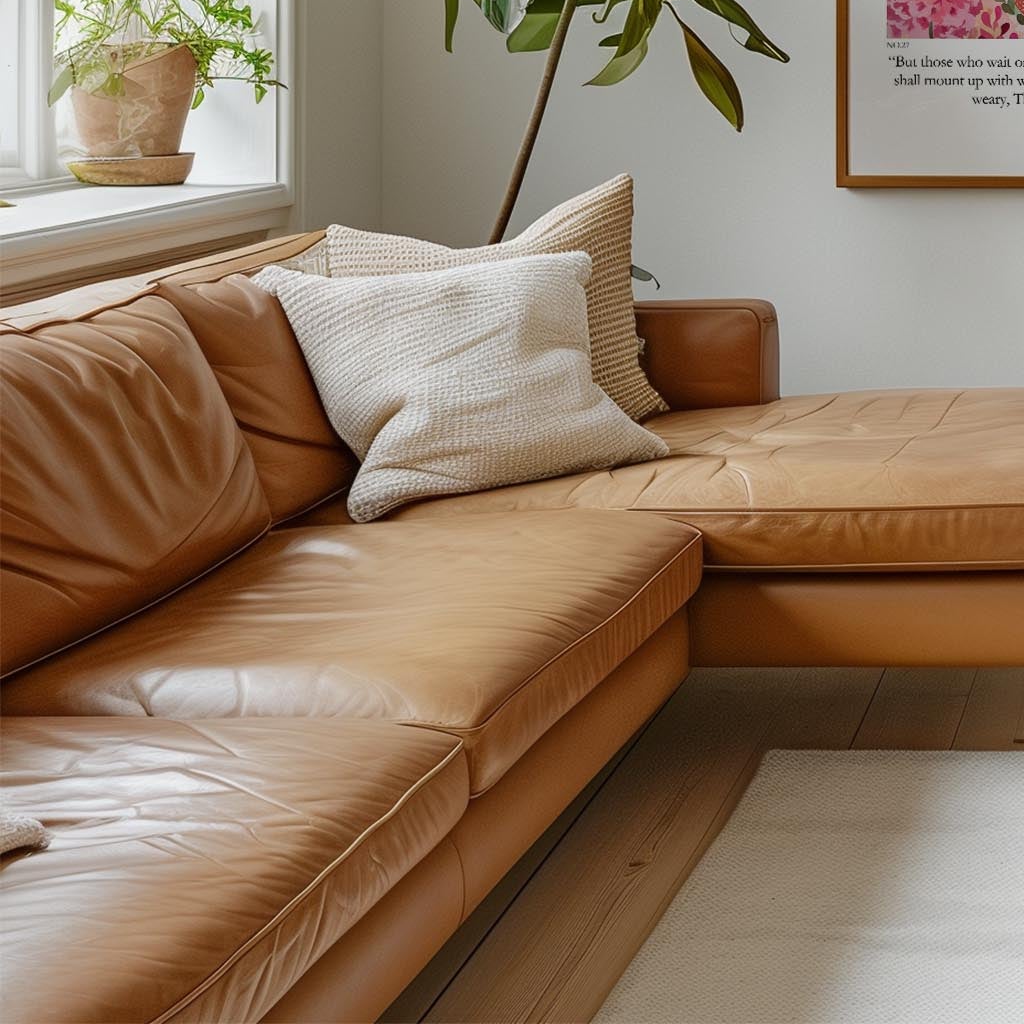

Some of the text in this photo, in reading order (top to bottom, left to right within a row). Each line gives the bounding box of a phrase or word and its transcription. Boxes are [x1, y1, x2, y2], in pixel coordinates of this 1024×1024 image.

[888, 55, 917, 68] “But
[921, 56, 953, 68] those
[957, 56, 983, 68] who
[987, 56, 1012, 68] wait
[894, 74, 920, 86] shall
[924, 77, 965, 86] mount
[968, 78, 983, 90] up
[987, 74, 1013, 86] with
[972, 95, 1010, 108] weary,
